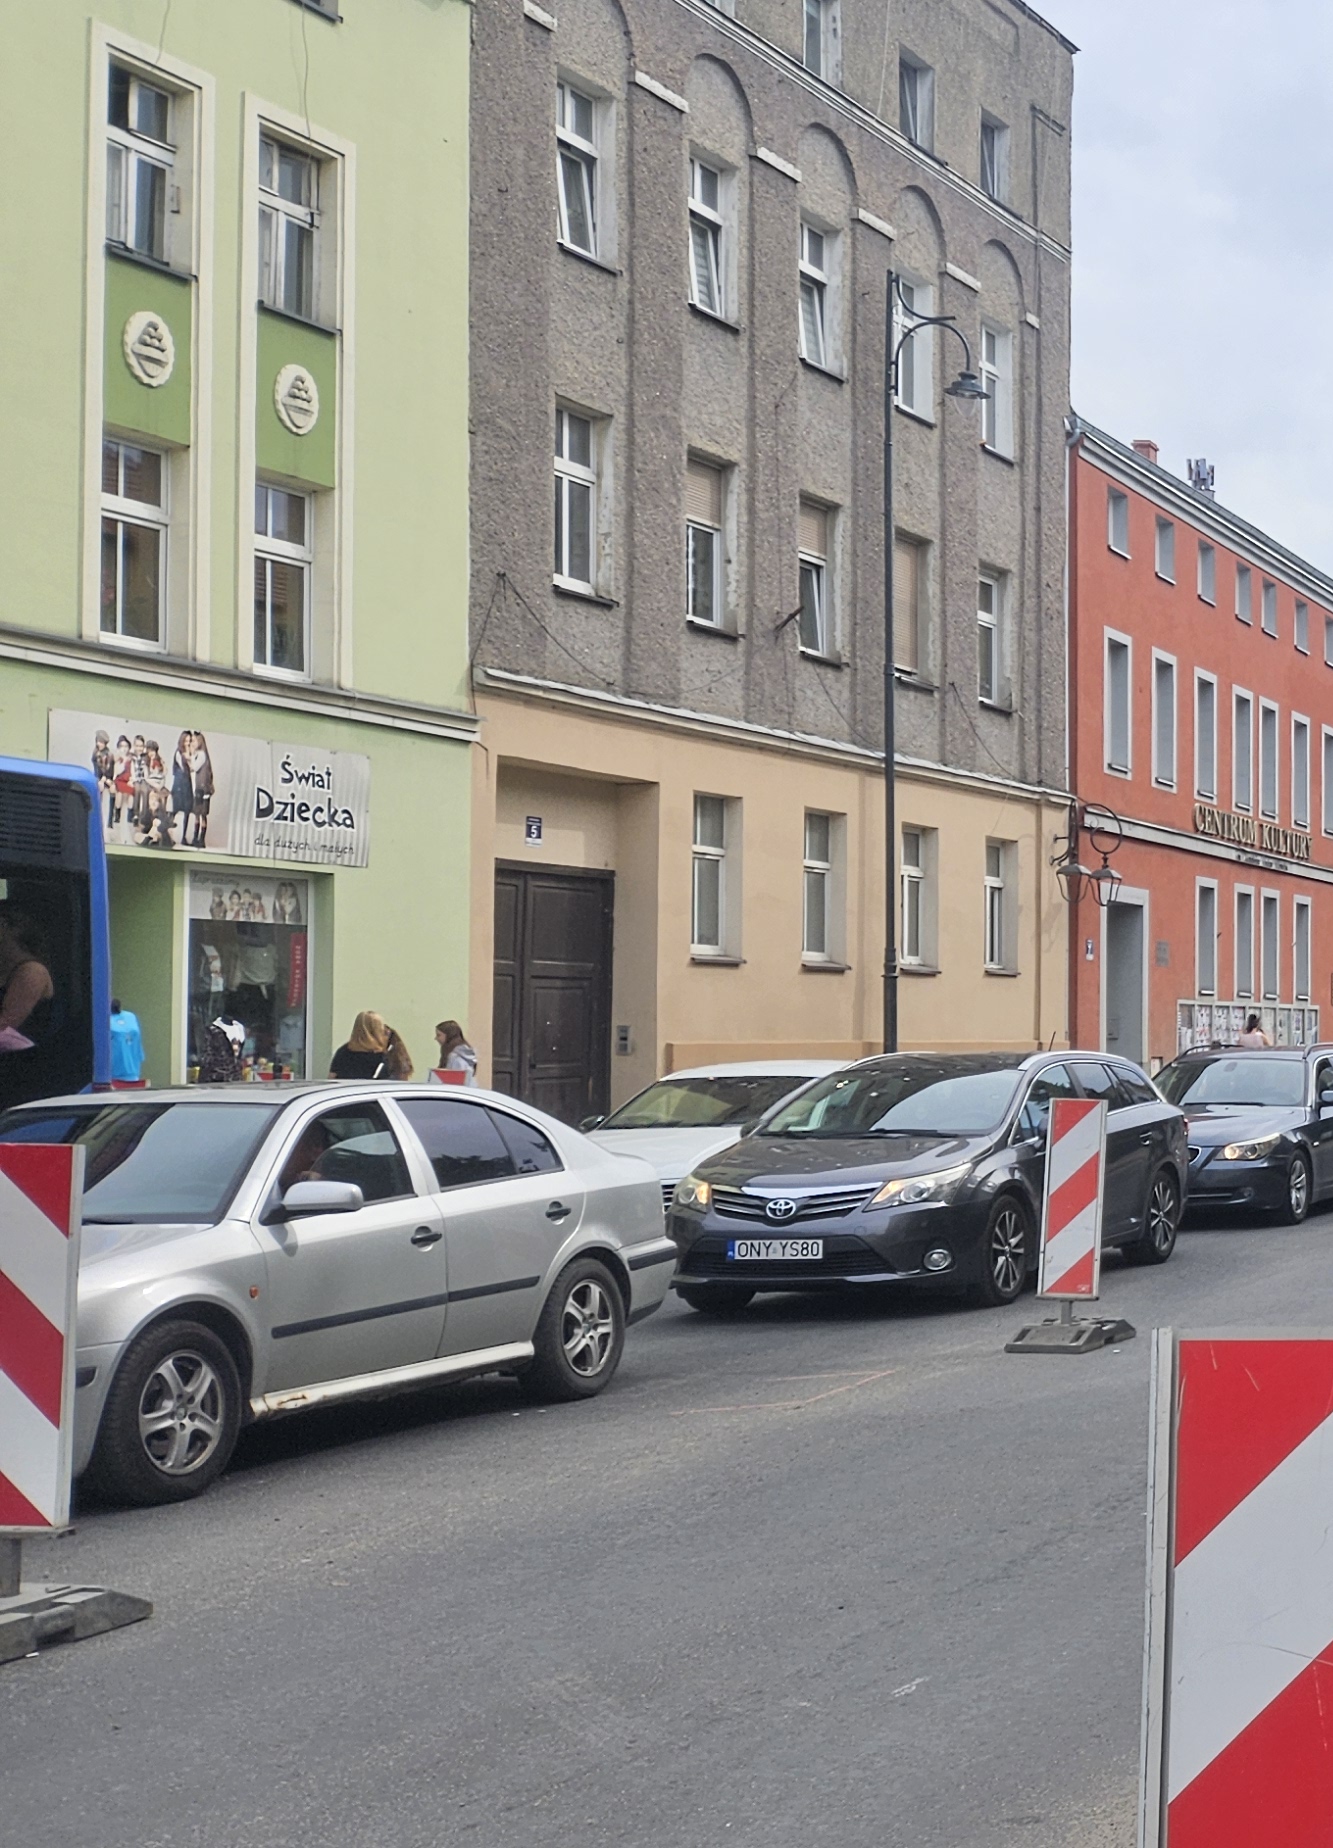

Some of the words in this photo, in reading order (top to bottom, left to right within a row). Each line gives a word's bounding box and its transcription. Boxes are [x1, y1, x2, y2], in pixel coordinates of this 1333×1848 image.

[280, 754, 332, 790] Świat
[255, 786, 355, 829] Dziecka
[254, 834, 270, 847] dla
[530, 825, 538, 838] 5
[1194, 803, 1258, 846] CENTRUM
[1260, 823, 1312, 859] KULTURY
[737, 1241, 773, 1258] ONY
[779, 1241, 820, 1257] YS80
